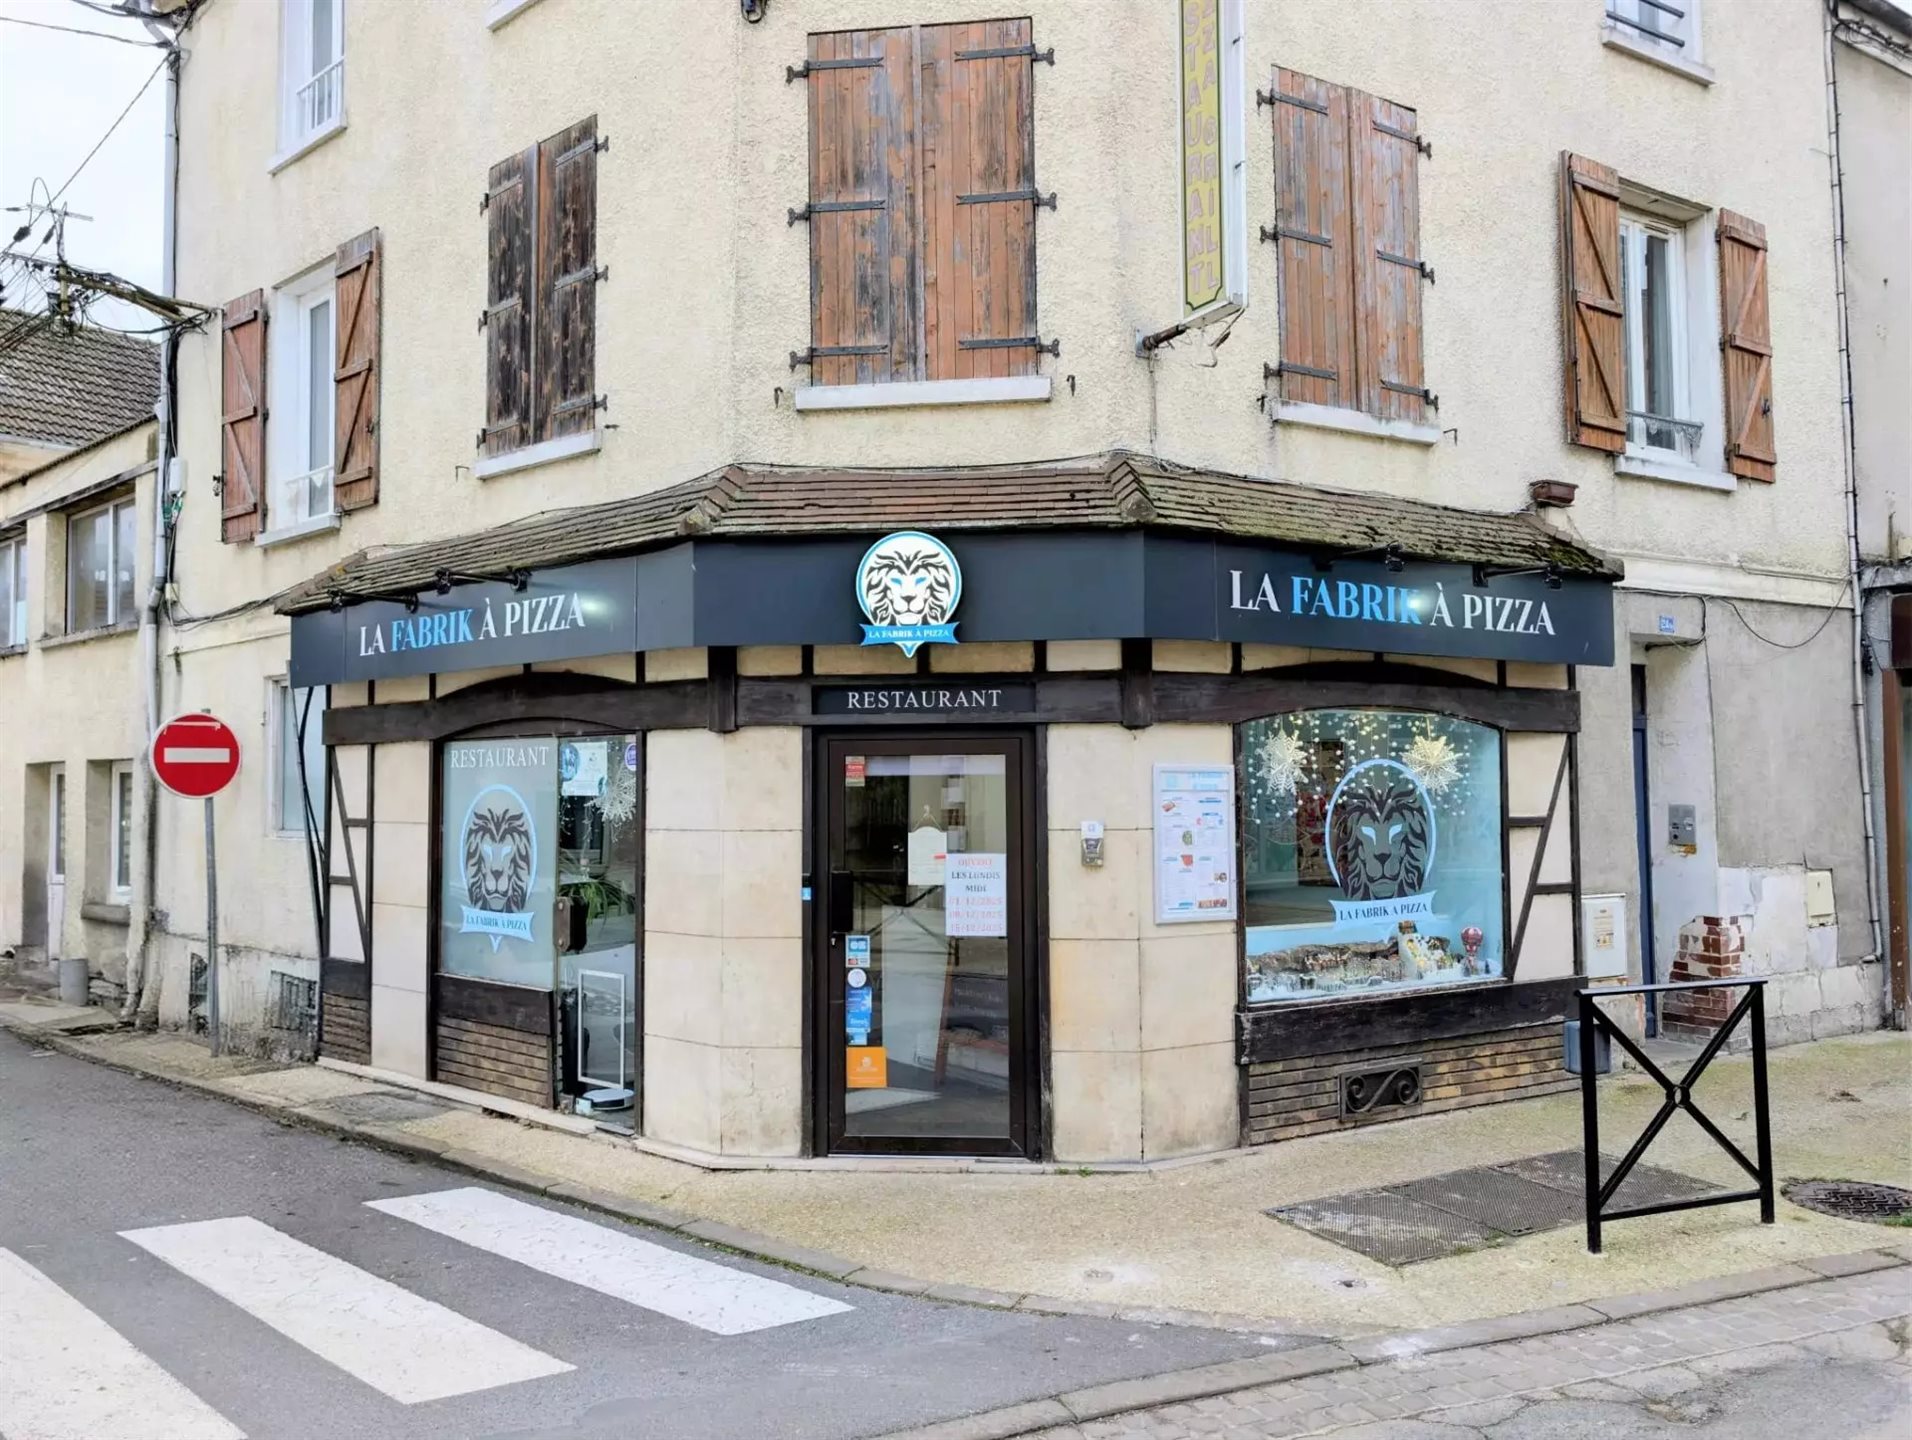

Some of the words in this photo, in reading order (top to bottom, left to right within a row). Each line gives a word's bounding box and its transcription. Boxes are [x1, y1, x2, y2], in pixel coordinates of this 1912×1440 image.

[1202, 115, 1219, 290] GRILL
[1229, 570, 1281, 613] LA
[1291, 575, 1422, 625] FABRIK
[1430, 582, 1454, 627] À
[1462, 593, 1556, 635] PIZZA
[359, 623, 386, 656] LA
[390, 609, 474, 652] FABRIK
[479, 597, 498, 641] À
[504, 591, 586, 637] PIZZA
[869, 630, 880, 639] LA
[881, 629, 914, 639] FABRIK
[923, 628, 950, 638] PIZZA
[847, 689, 1002, 709] RESTAURANT
[450, 746, 549, 769] RESTAURANT
[951, 871, 967, 879] LES
[968, 871, 1001, 880] LUNDIS
[966, 884, 987, 892] MIDI
[1340, 909, 1352, 920] LA
[1355, 906, 1389, 920] FABRIK
[1400, 902, 1428, 914] PIZZA
